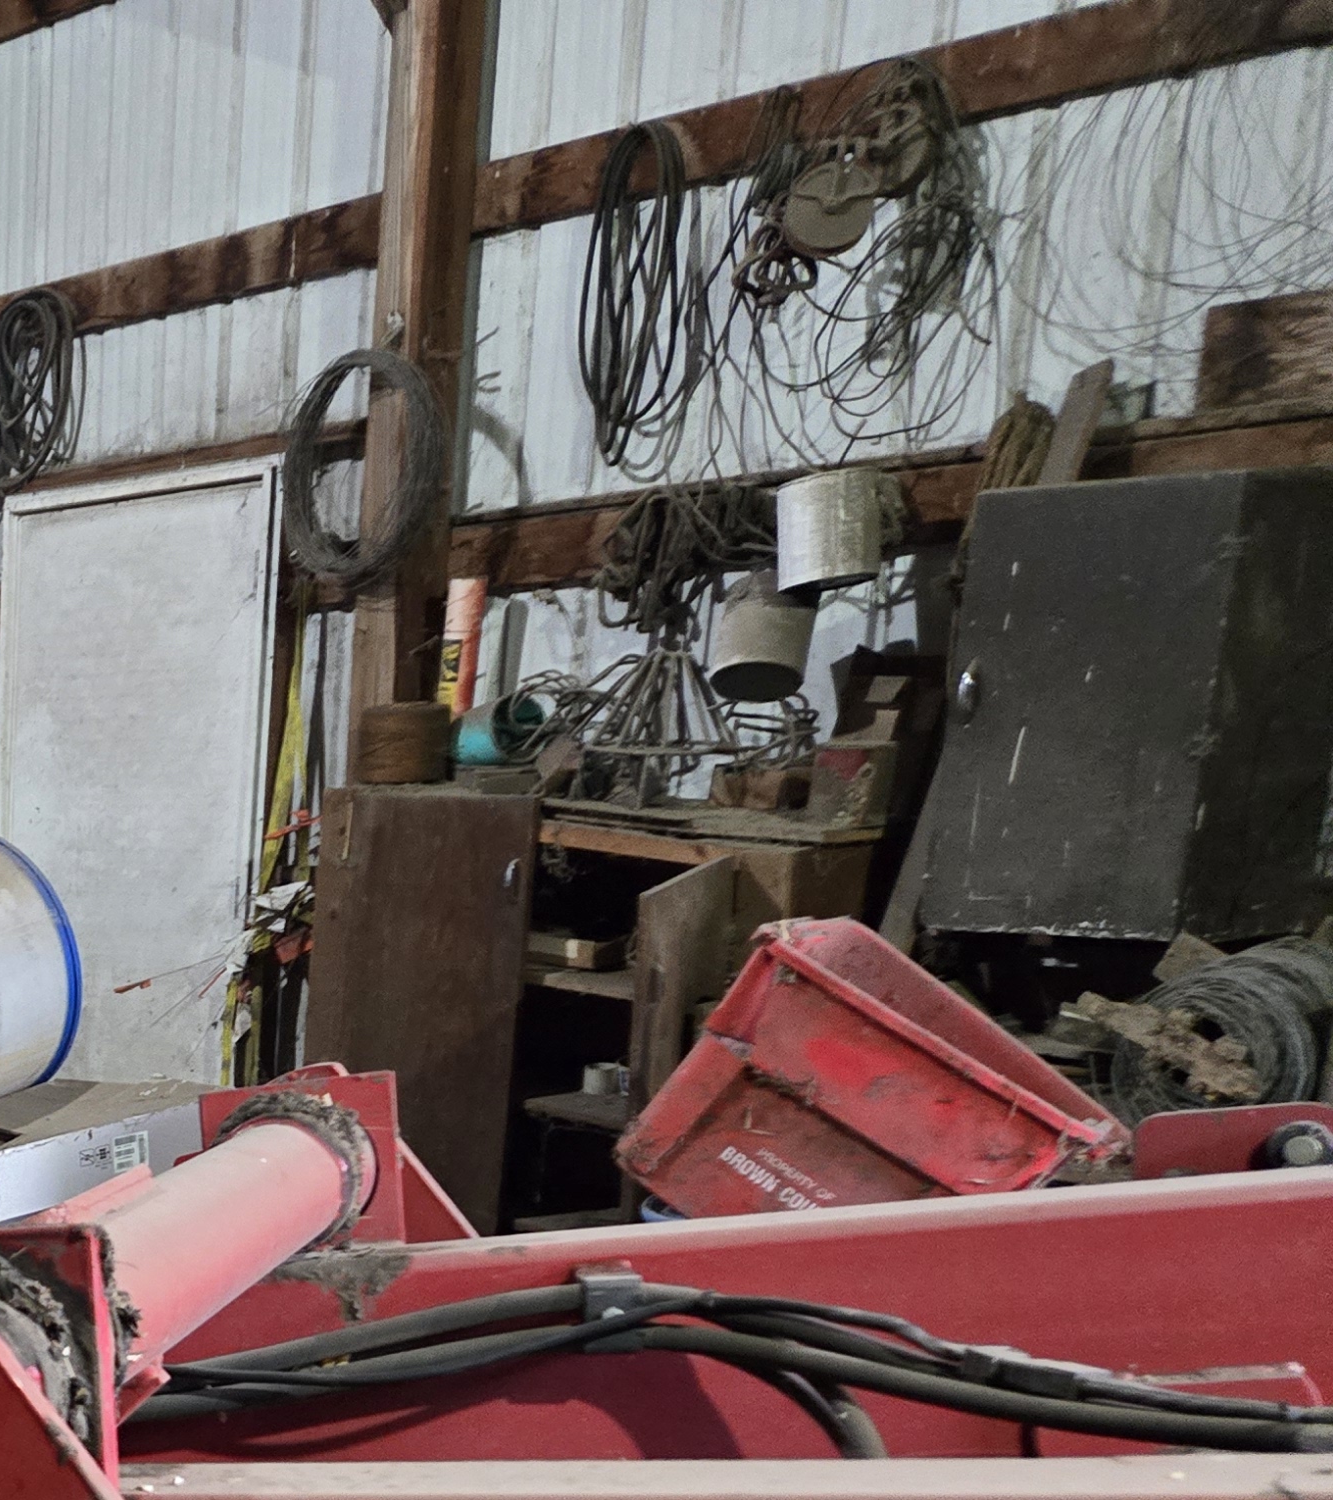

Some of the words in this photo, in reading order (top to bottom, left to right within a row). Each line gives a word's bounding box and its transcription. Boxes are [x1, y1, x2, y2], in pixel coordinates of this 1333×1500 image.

[717, 1145, 781, 1193] BROWN
[755, 1147, 818, 1189] PROPERTY
[814, 1187, 837, 1200] OF
